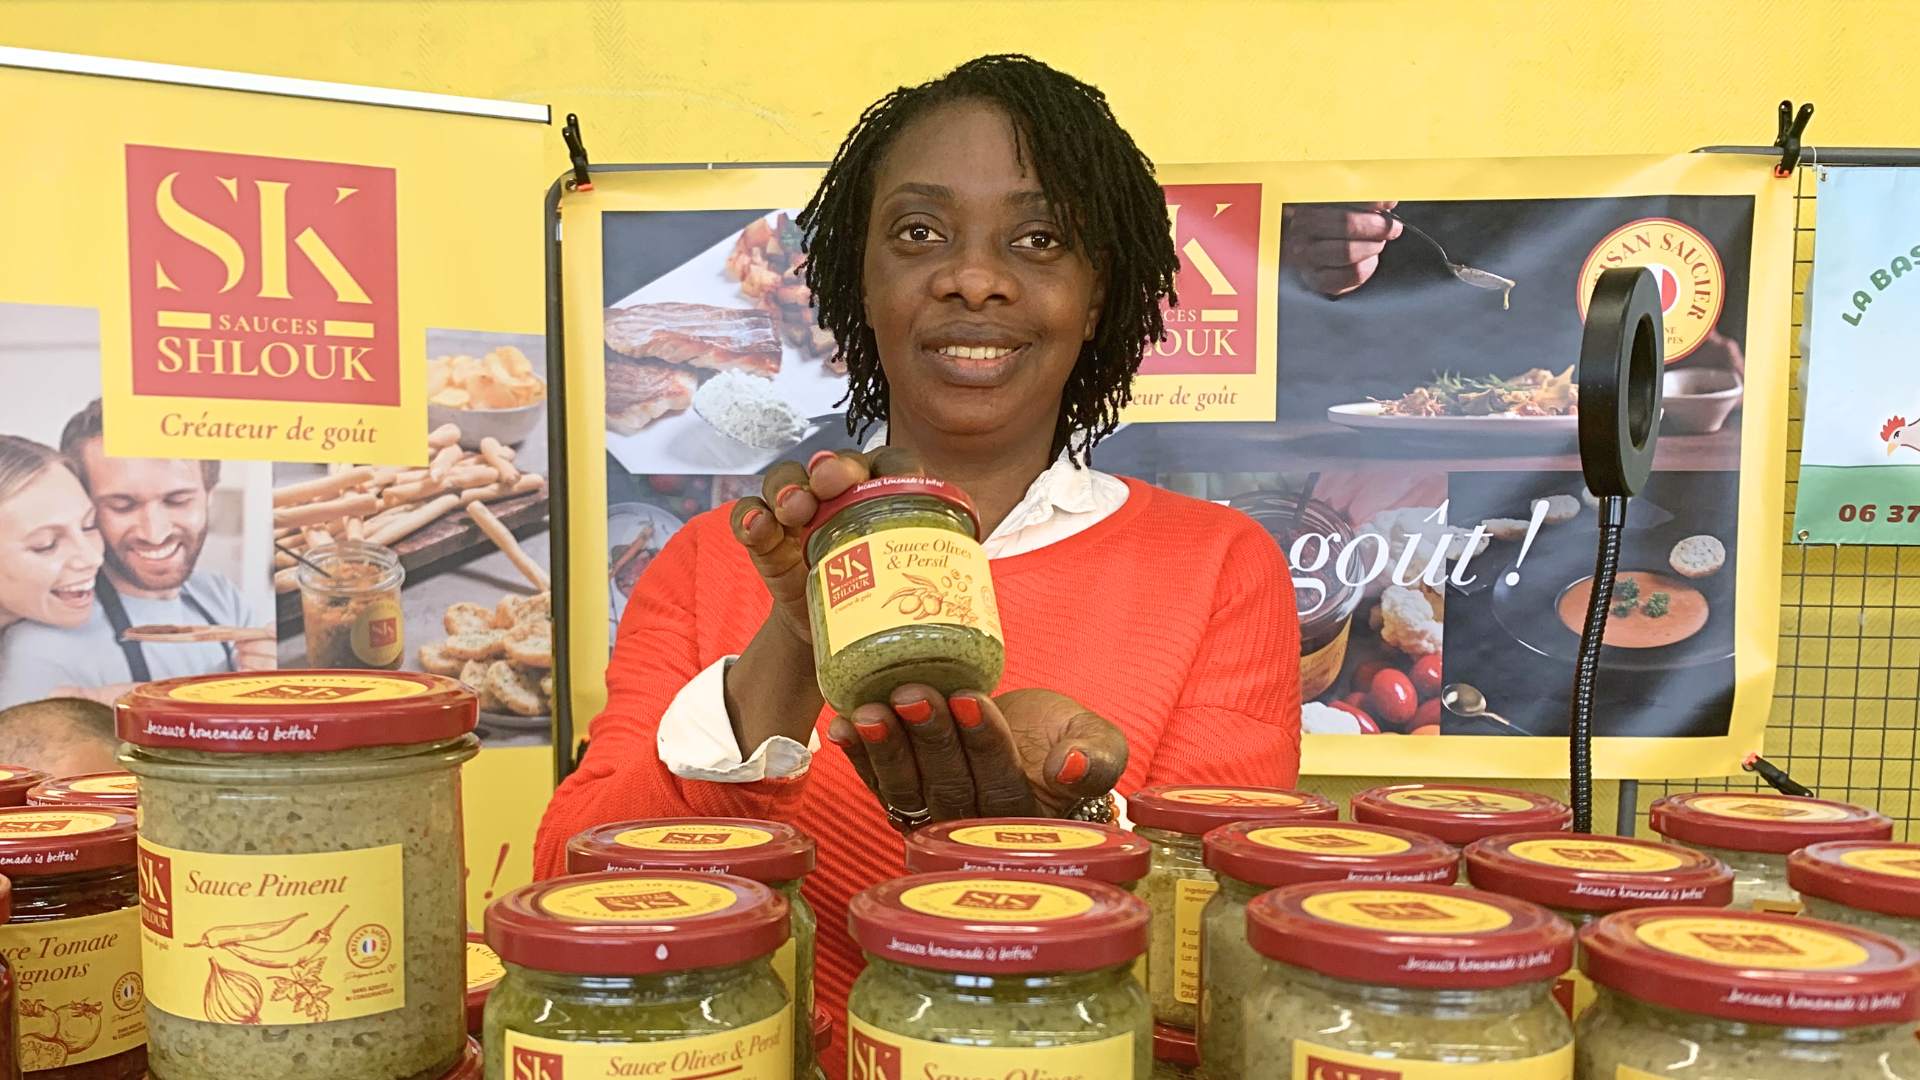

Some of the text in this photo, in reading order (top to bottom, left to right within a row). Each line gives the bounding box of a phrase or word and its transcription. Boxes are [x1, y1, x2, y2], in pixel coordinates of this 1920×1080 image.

[155, 171, 374, 305] SK
[1165, 203, 1239, 296] K
[1660, 233, 1711, 320] SAUCIER
[1163, 309, 1197, 323] CES
[1841, 290, 1873, 327] LA
[218, 314, 319, 336] SAUCES
[1143, 328, 1239, 357] OUK
[157, 336, 376, 383] SHLOUK
[1169, 384, 1191, 406] de
[1194, 384, 1239, 412] goût
[160, 412, 378, 451] Créateur de goût
[883, 477, 917, 486] homemade
[1838, 504, 1920, 523] 06 37
[883, 538, 972, 560] Sauce Olives
[886, 553, 948, 570] & Persil
[1289, 498, 1550, 616] goût !
[828, 548, 868, 587] SK
[832, 578, 871, 603] SHLOUK
[188, 722, 255, 741] homemade
[257, 725, 270, 741] is
[273, 724, 319, 741] better!
[0, 849, 79, 865] emade is better!
[184, 869, 349, 898] Sauce Piment
[1618, 884, 1670, 900] homemade
[1671, 889, 1679, 901] is
[39, 933, 118, 959] Tomate
[16, 962, 91, 992] ignons
[606, 1056, 667, 1077] Sauce
[670, 1048, 729, 1072] Olives
[731, 1039, 746, 1061] &
